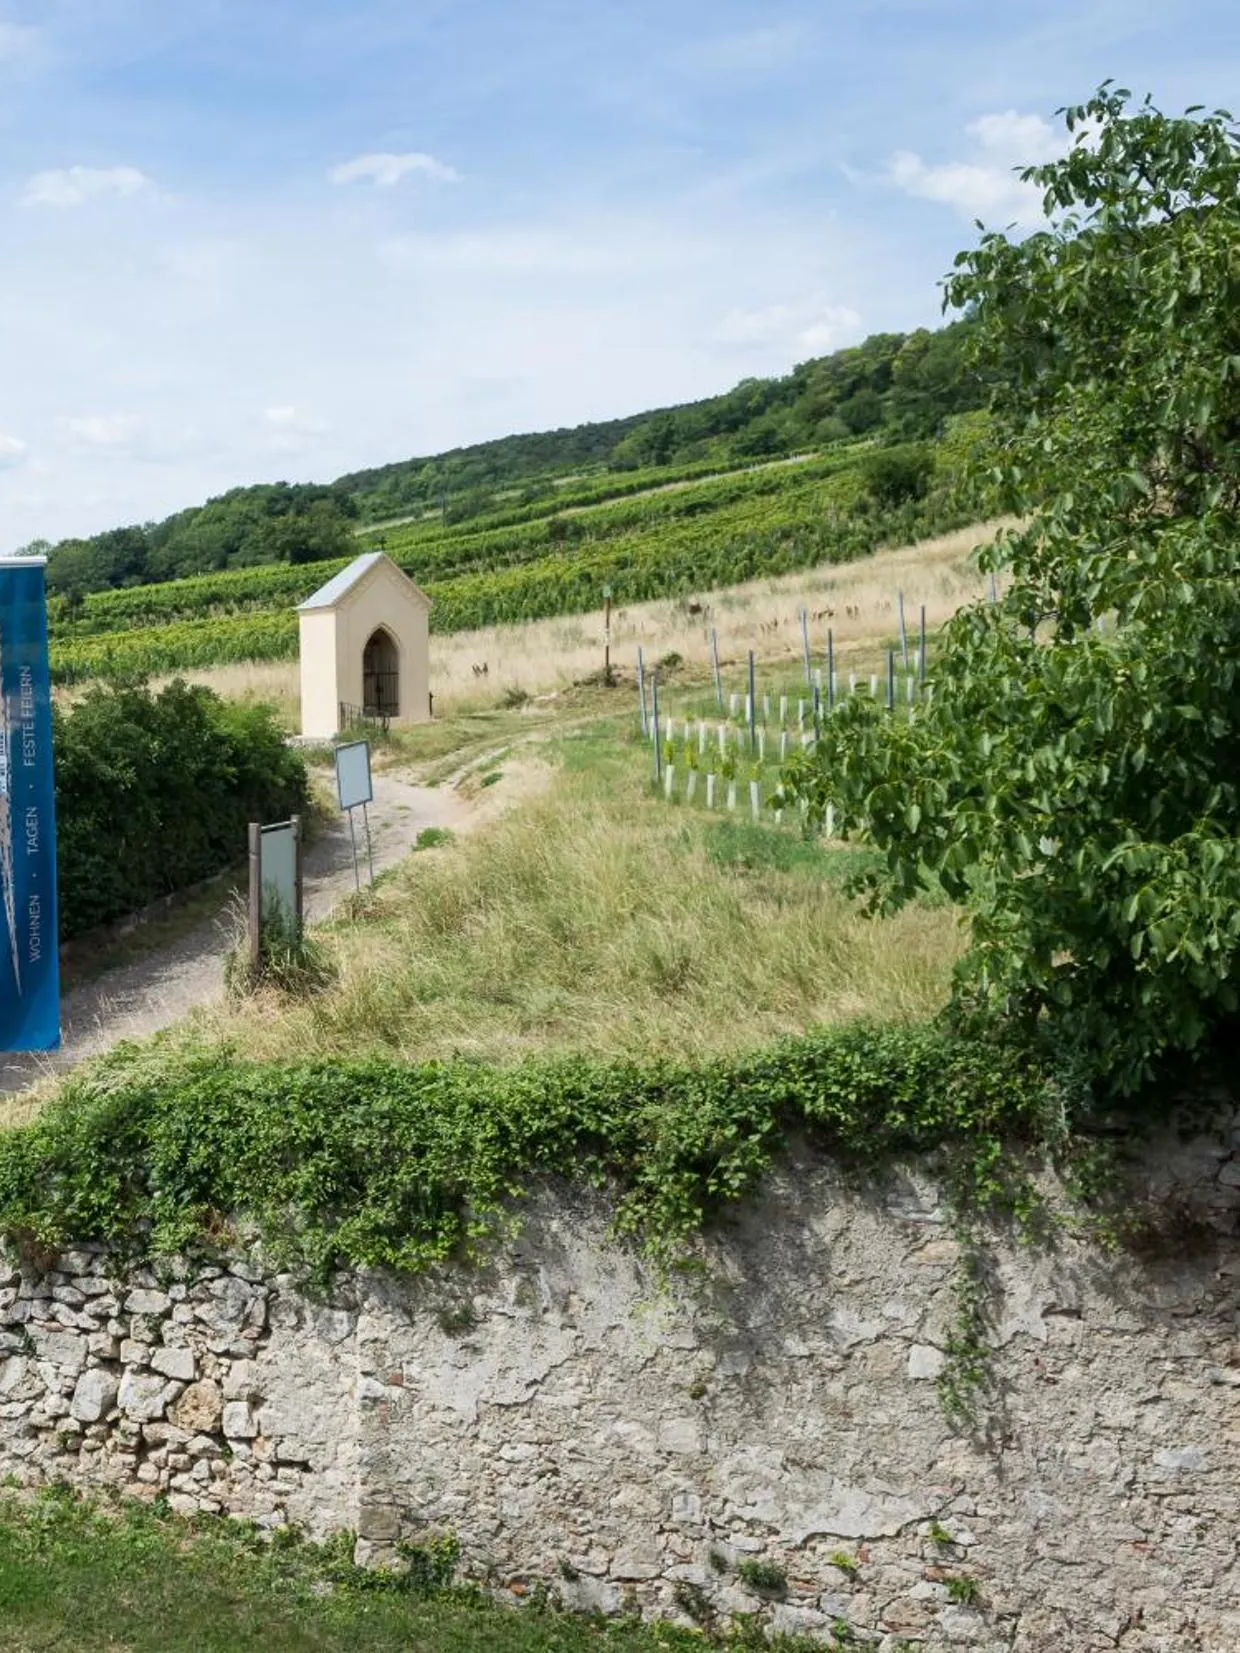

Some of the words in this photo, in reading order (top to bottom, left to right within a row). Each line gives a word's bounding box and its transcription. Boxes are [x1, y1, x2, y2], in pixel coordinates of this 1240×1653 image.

[19, 665, 36, 718] FEIERN
[22, 722, 36, 767] FESTE
[25, 806, 40, 855] TAGEN
[29, 895, 41, 964] WOHNEN
